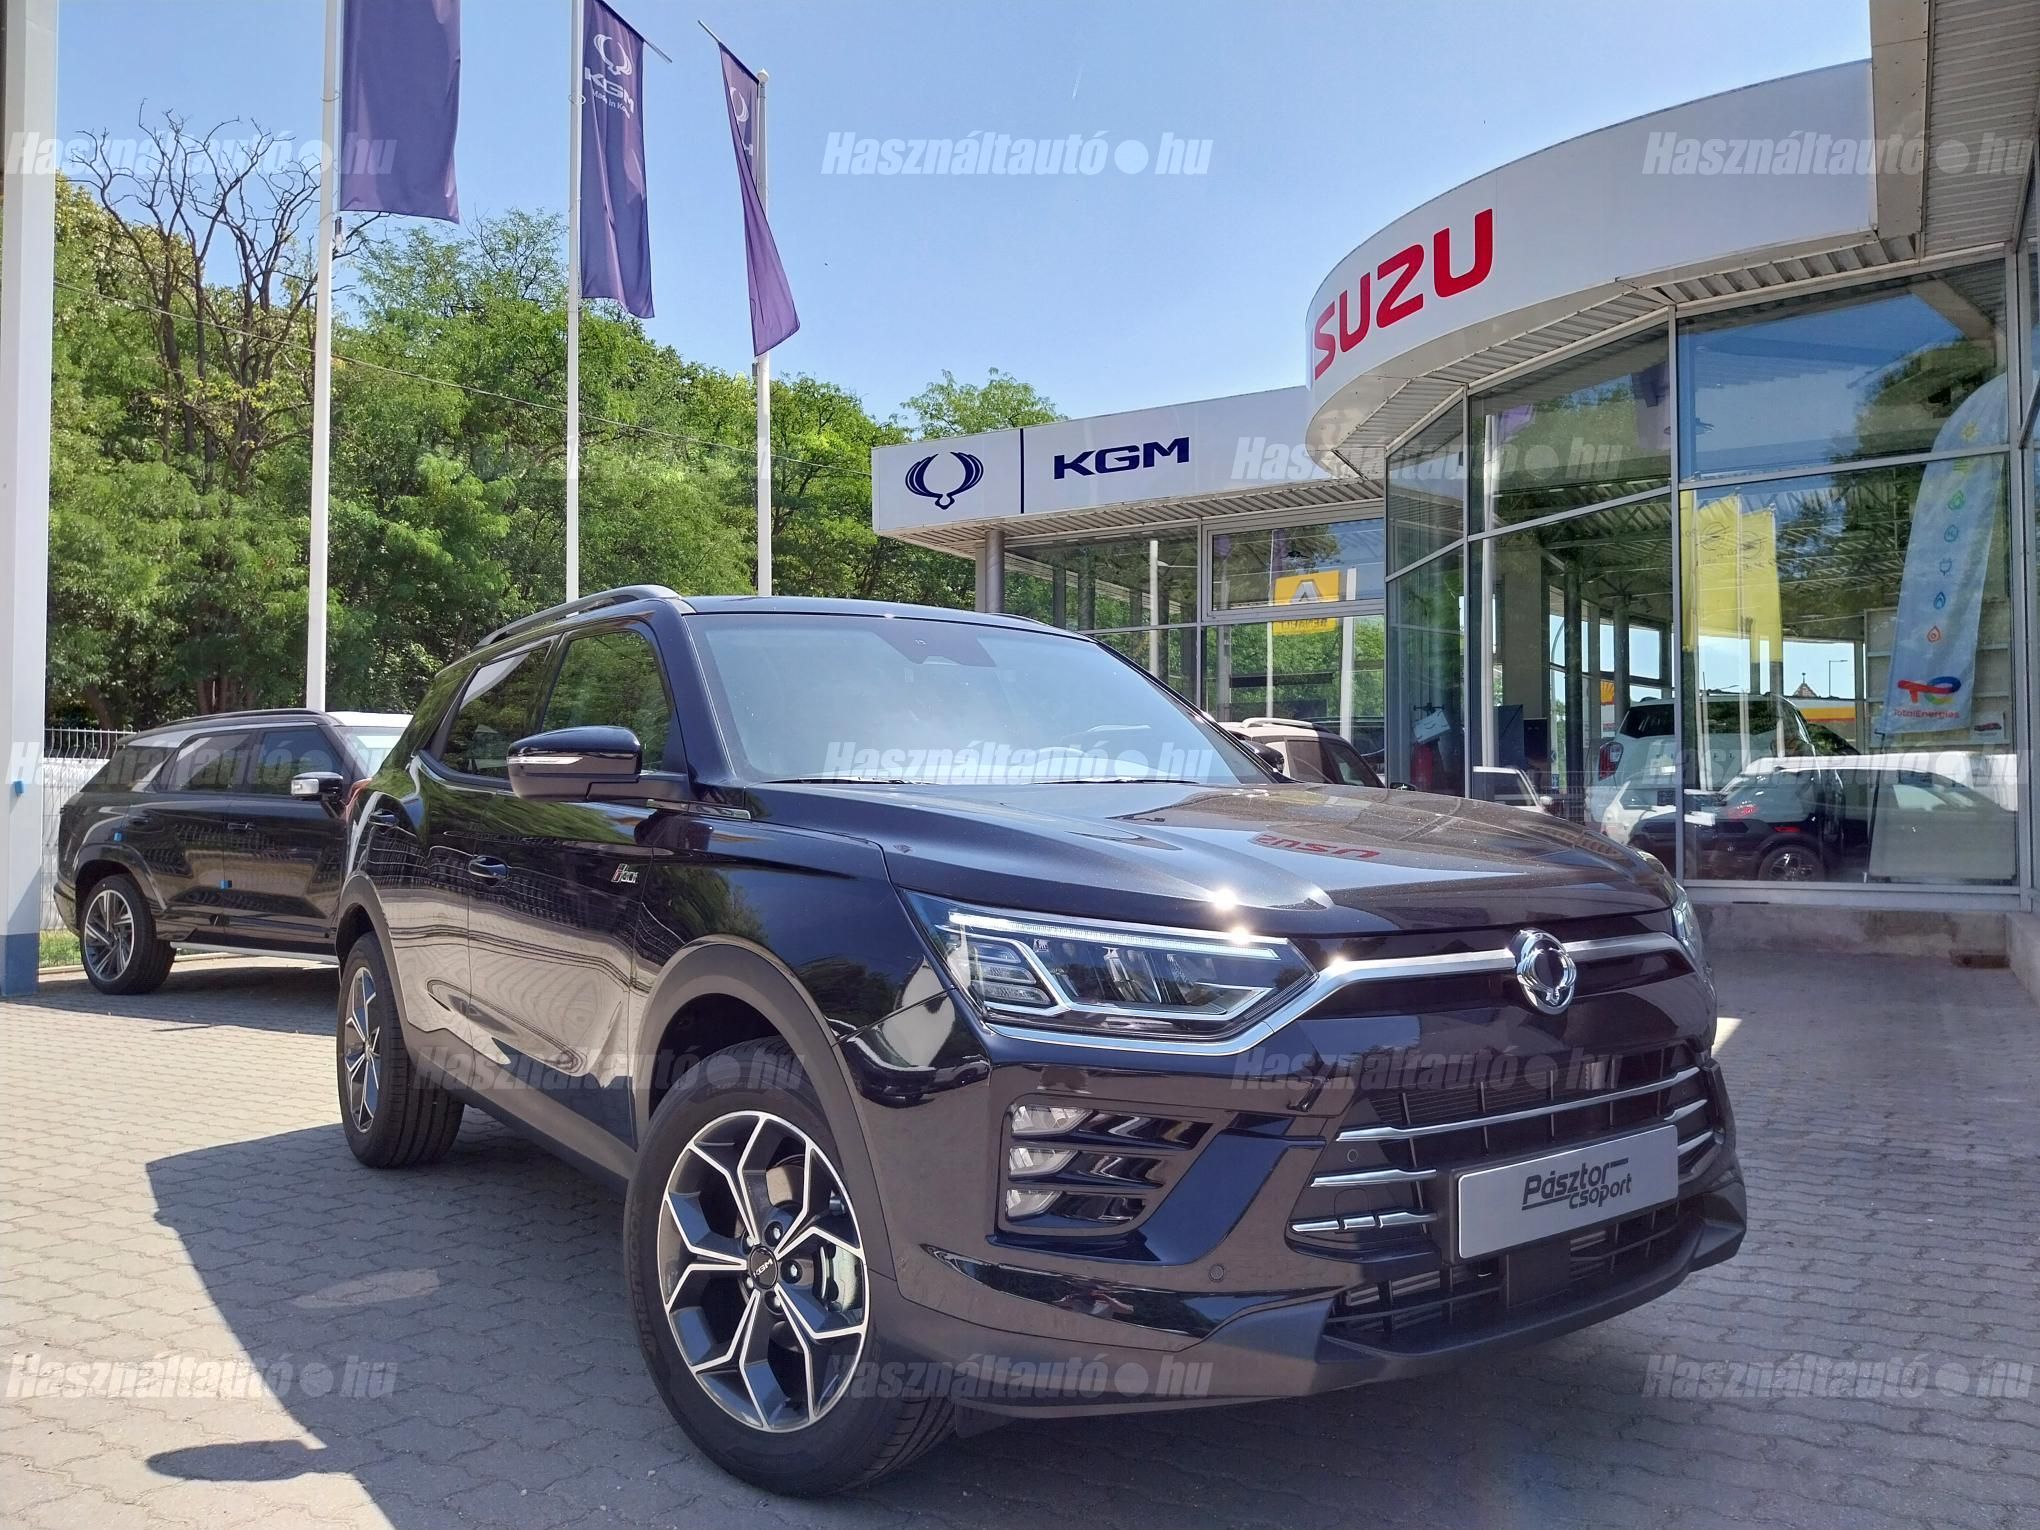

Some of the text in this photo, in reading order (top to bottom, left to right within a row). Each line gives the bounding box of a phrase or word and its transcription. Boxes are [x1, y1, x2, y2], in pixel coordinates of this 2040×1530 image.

[584, 66, 634, 114] KGM
[1053, 436, 1190, 480] KGM
[1522, 1158, 1629, 1205] Pásztor
[1568, 1173, 1632, 1209] csoport
